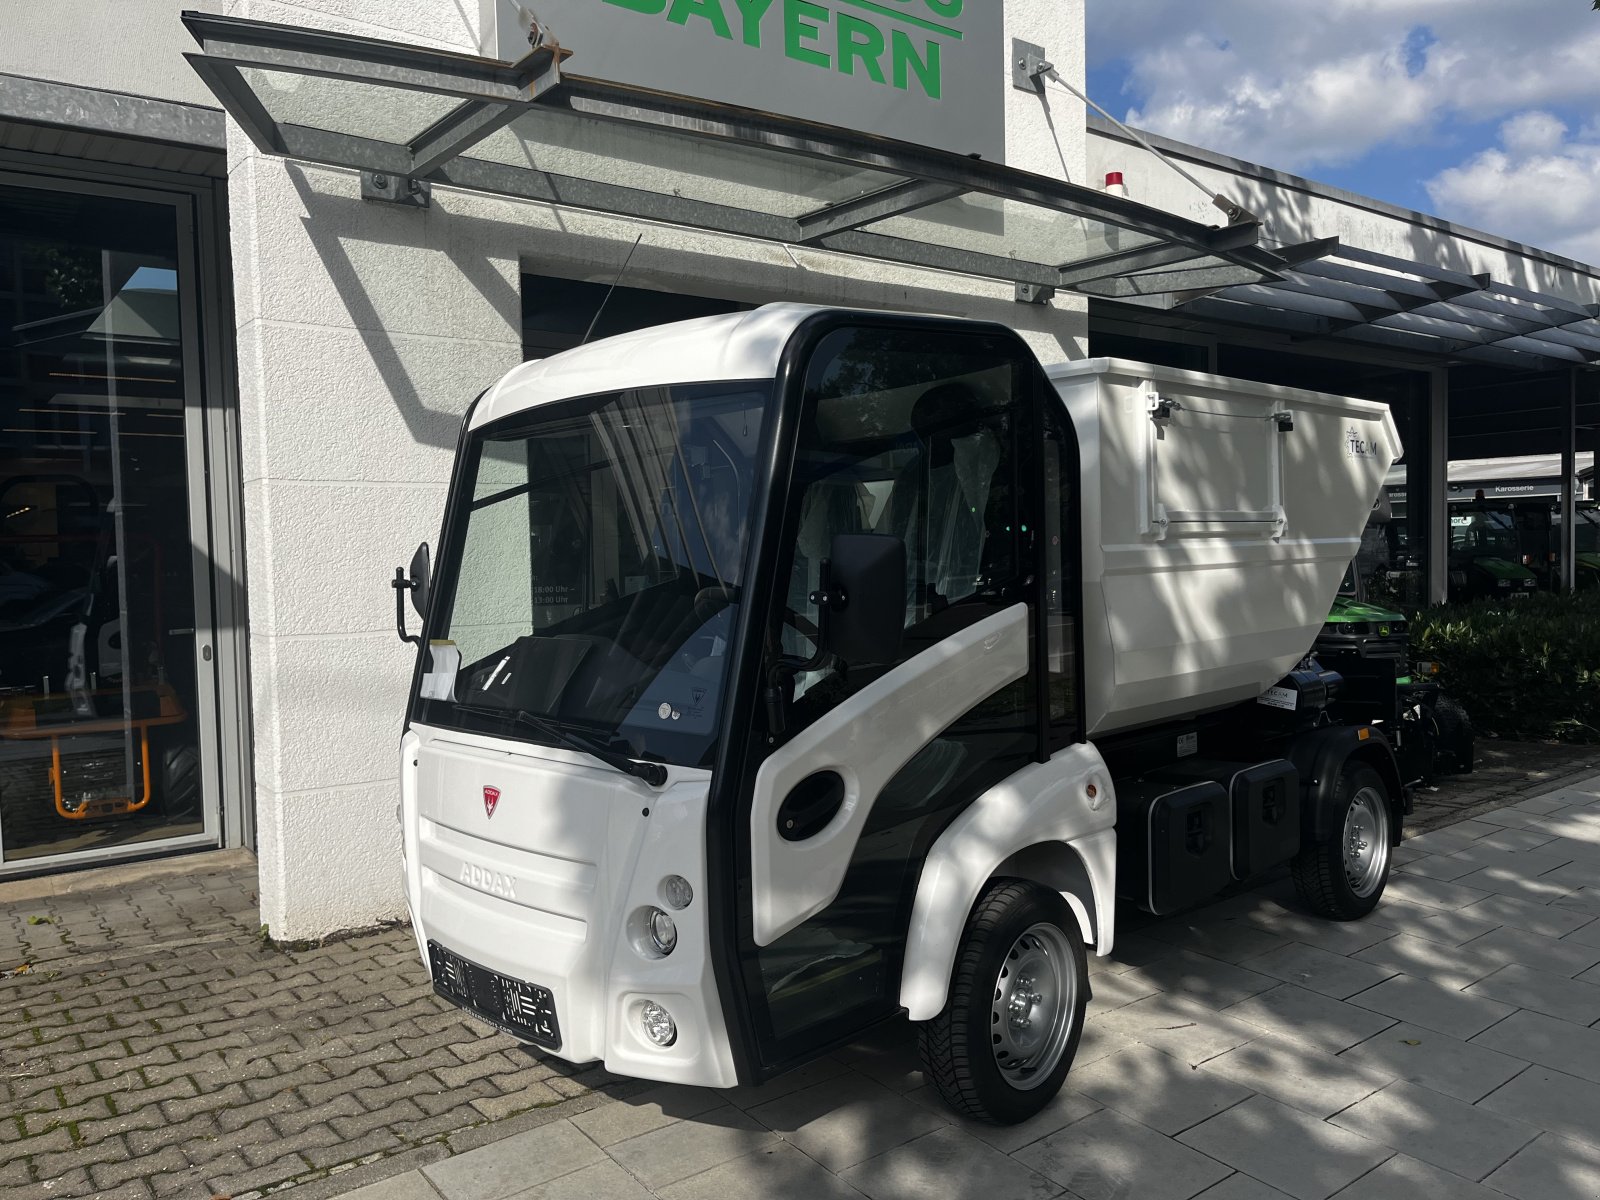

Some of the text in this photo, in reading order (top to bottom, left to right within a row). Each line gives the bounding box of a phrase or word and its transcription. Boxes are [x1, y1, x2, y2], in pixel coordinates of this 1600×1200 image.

[600, 0, 941, 99] AYERN
[1350, 439, 1377, 455] TECAM
[1495, 485, 1534, 493] Karosserie
[555, 585, 569, 593] Uhr
[555, 596, 569, 604] Uhr
[460, 861, 517, 899] ADDAX
